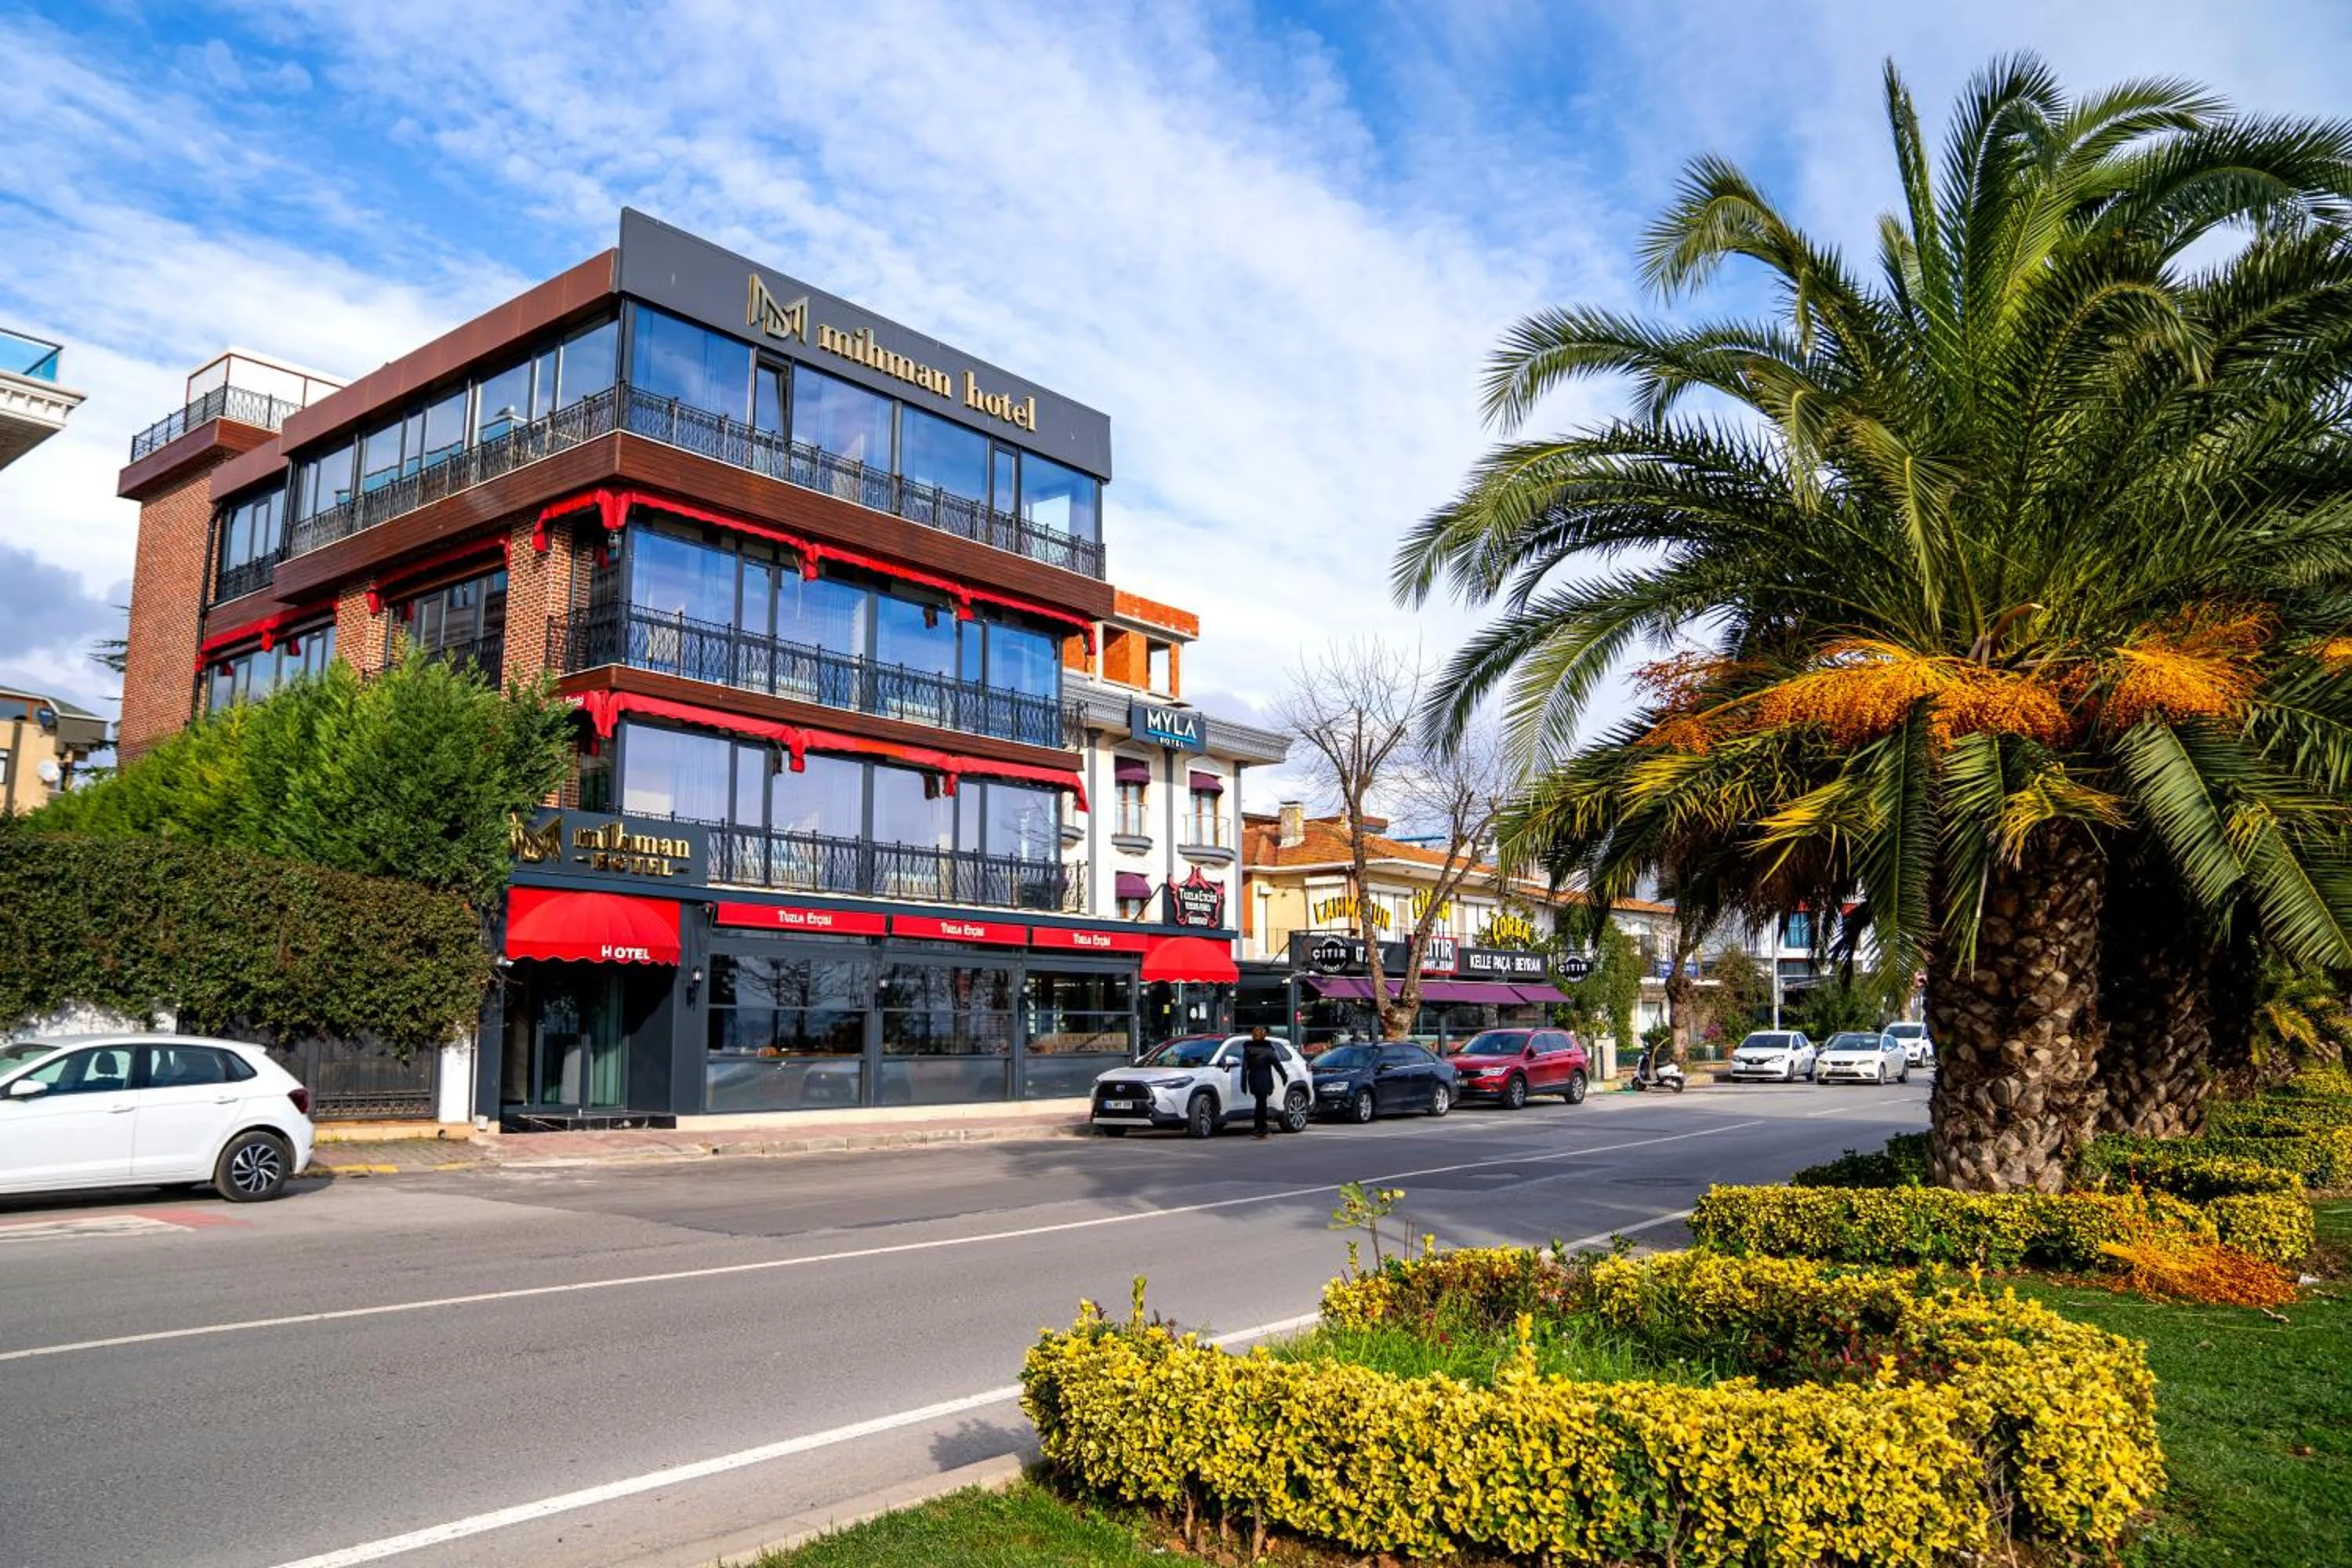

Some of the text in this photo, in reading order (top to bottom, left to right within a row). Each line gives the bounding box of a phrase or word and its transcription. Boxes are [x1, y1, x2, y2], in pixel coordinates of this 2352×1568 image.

[816, 324, 1037, 432] mihman hotel
[1147, 708, 1197, 739] MYLA
[1160, 737, 1185, 748] HOTEL
[573, 821, 690, 858] mihman
[591, 852, 673, 877] HOTEL
[1313, 896, 1390, 931] LAHMAUN
[1492, 915, 1531, 946] ÇORBA
[601, 945, 651, 960] HOTEL
[1425, 938, 1454, 960] ITIR
[1469, 953, 1491, 970] KELLE
[1493, 955, 1512, 974] PAÇA
